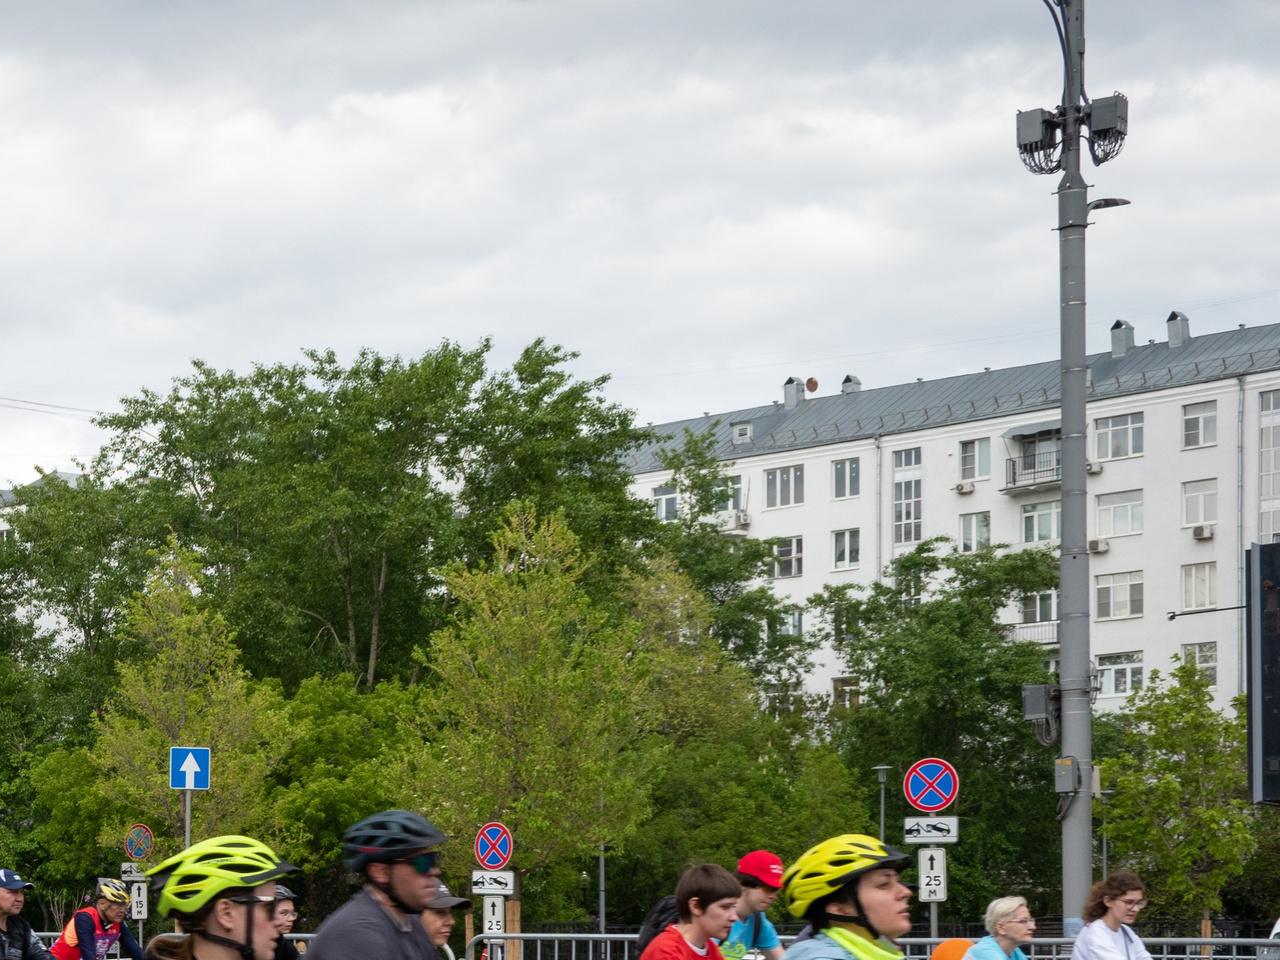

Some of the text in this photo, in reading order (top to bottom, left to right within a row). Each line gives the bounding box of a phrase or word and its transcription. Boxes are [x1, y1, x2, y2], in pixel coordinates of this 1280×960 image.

[925, 875, 942, 887] 25
[135, 900, 144, 908] 15
[487, 920, 502, 931] 25
